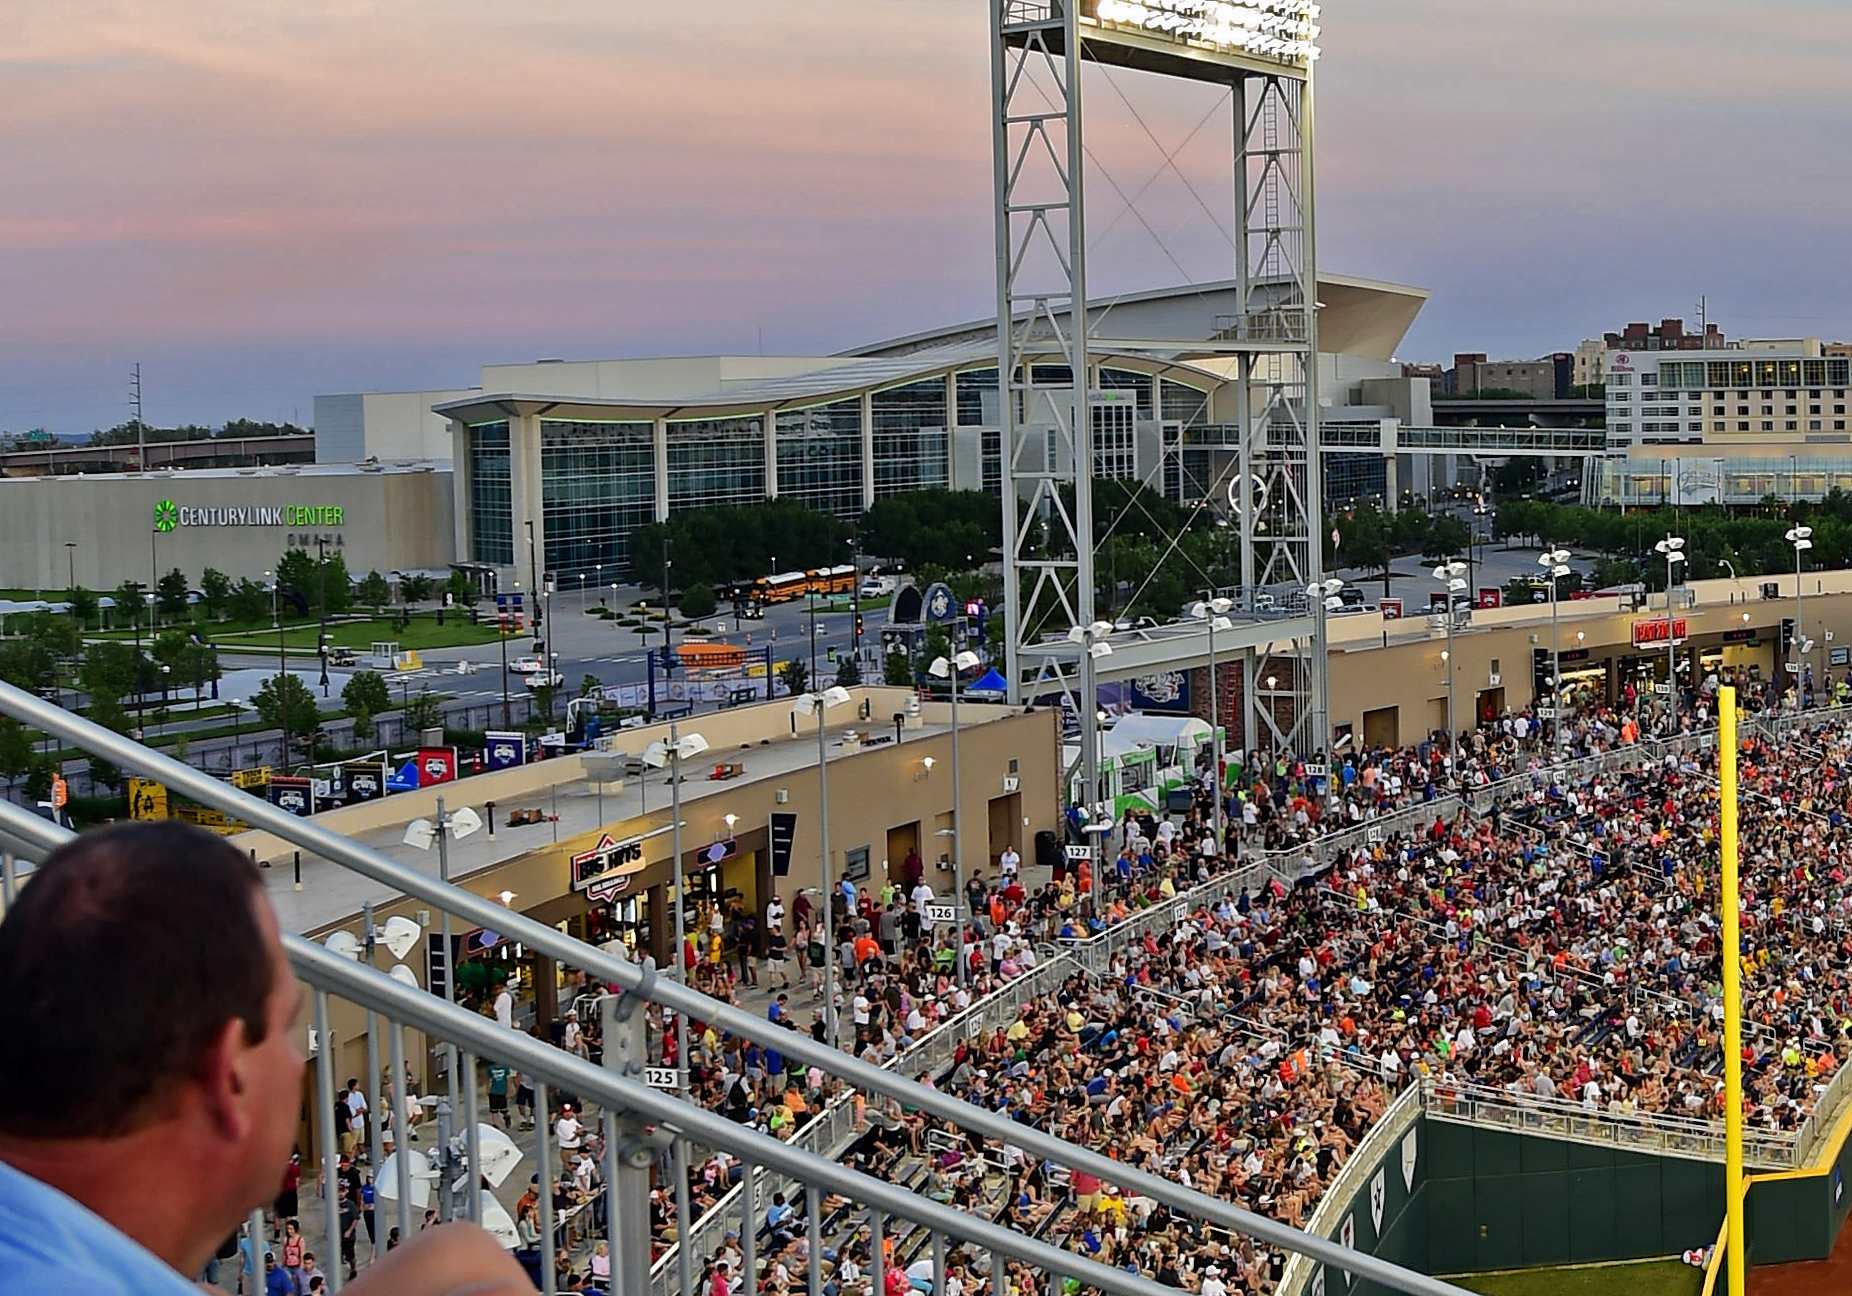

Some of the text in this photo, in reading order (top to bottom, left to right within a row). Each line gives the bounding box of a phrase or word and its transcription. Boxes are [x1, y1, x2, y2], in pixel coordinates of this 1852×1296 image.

[180, 505, 345, 526] CENTURYLINK CENTER
[1070, 848, 1087, 857] 127
[931, 908, 952, 919] 126
[647, 1070, 674, 1085] 125
